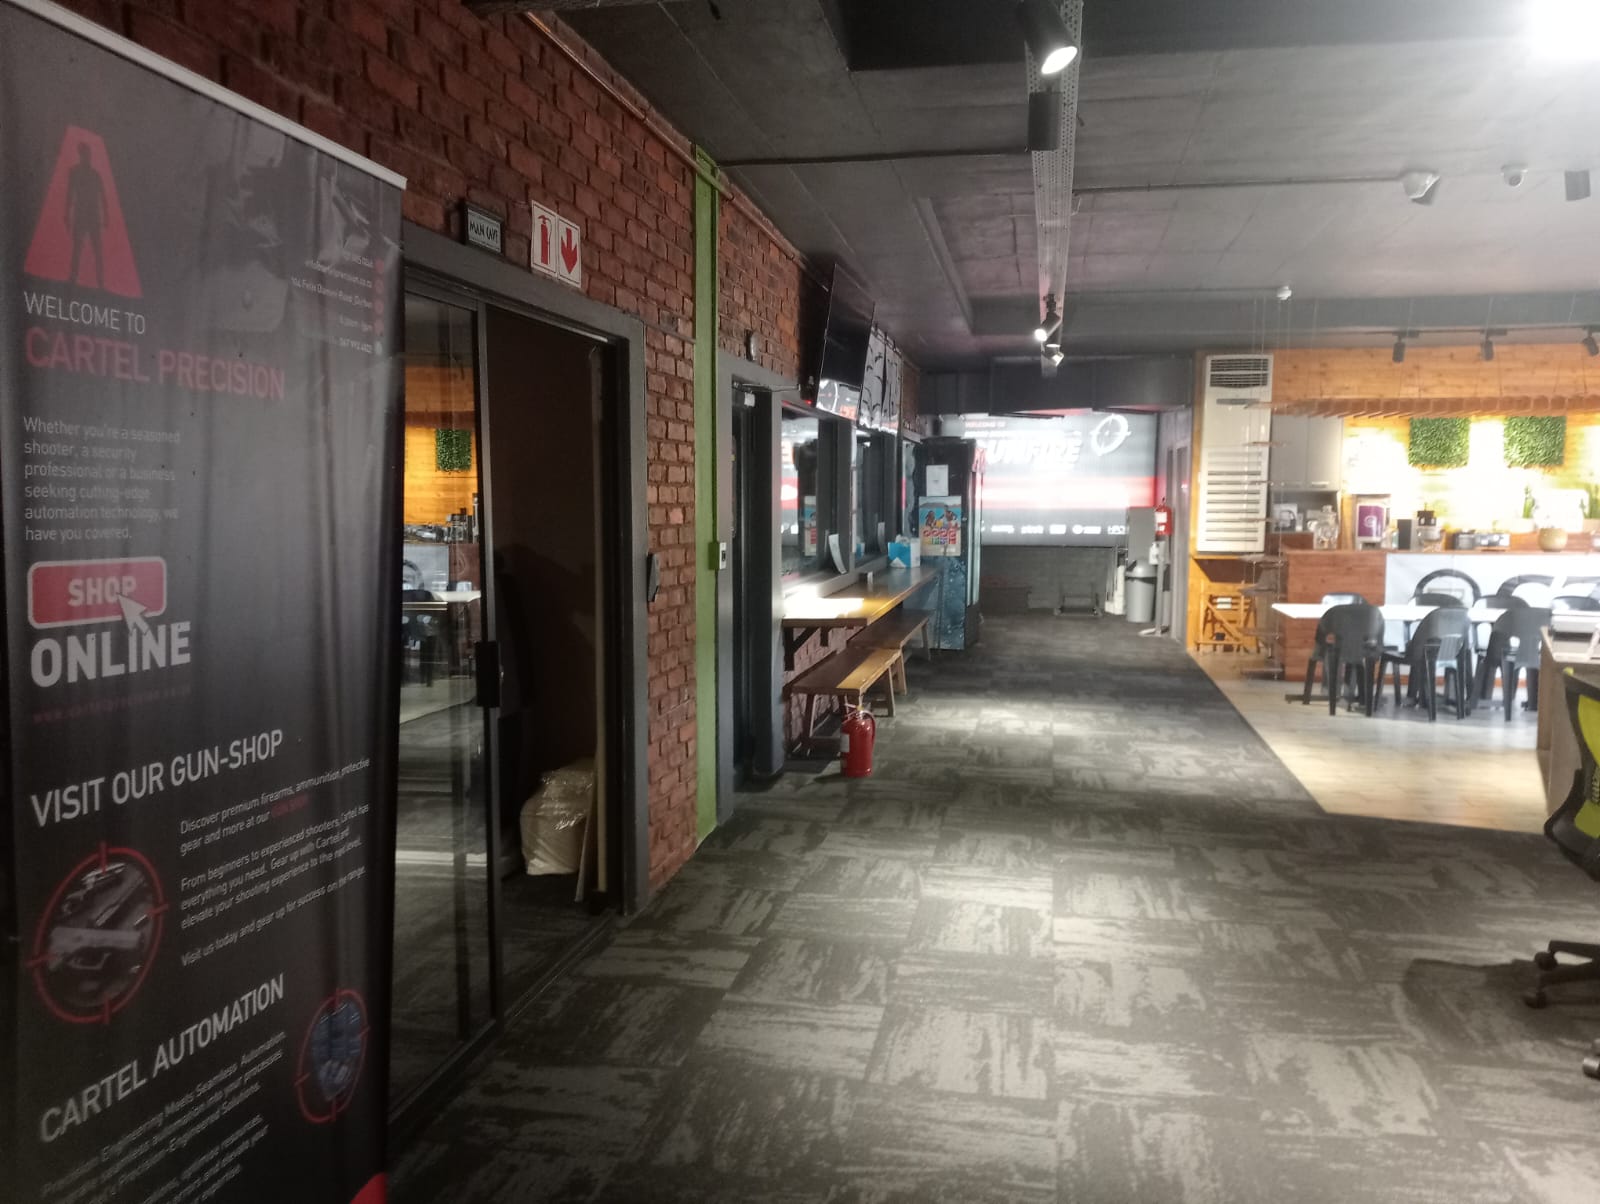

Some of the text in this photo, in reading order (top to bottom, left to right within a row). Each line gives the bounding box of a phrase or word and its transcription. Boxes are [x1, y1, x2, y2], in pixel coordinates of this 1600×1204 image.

[469, 221, 499, 244] MAN CAVE
[24, 292, 146, 334] WELCOME TO
[25, 327, 284, 399] CARTEL PRECISION
[23, 416, 181, 443] Whether you're a seasoned
[23, 439, 137, 463] shooter, a security
[24, 461, 176, 481] professional or a business
[24, 483, 77, 502] seeking
[24, 505, 98, 519] automation
[25, 525, 132, 544] have you covered.
[68, 575, 137, 608] SHOP
[30, 621, 191, 688] ONLINE
[31, 729, 283, 827] VISIT OUR GUN-SHOP
[180, 811, 221, 834] Discover
[221, 798, 260, 822] premium
[180, 811, 270, 857] gear and more at our
[180, 873, 206, 891] From
[207, 854, 250, 880] beginners
[251, 849, 260, 862] to
[260, 829, 305, 857] experienced
[180, 883, 227, 910] everything
[229, 875, 244, 892] you
[270, 855, 288, 870] Gear
[180, 907, 214, 930] elevate
[214, 897, 234, 916] your
[235, 880, 271, 904] shooting
[180, 949, 201, 966] Visit
[202, 943, 215, 957] us
[215, 931, 239, 949] today
[239, 921, 255, 937] and
[256, 912, 275, 931] gear
[40, 972, 284, 1143] CARTEL AUTOMATION
